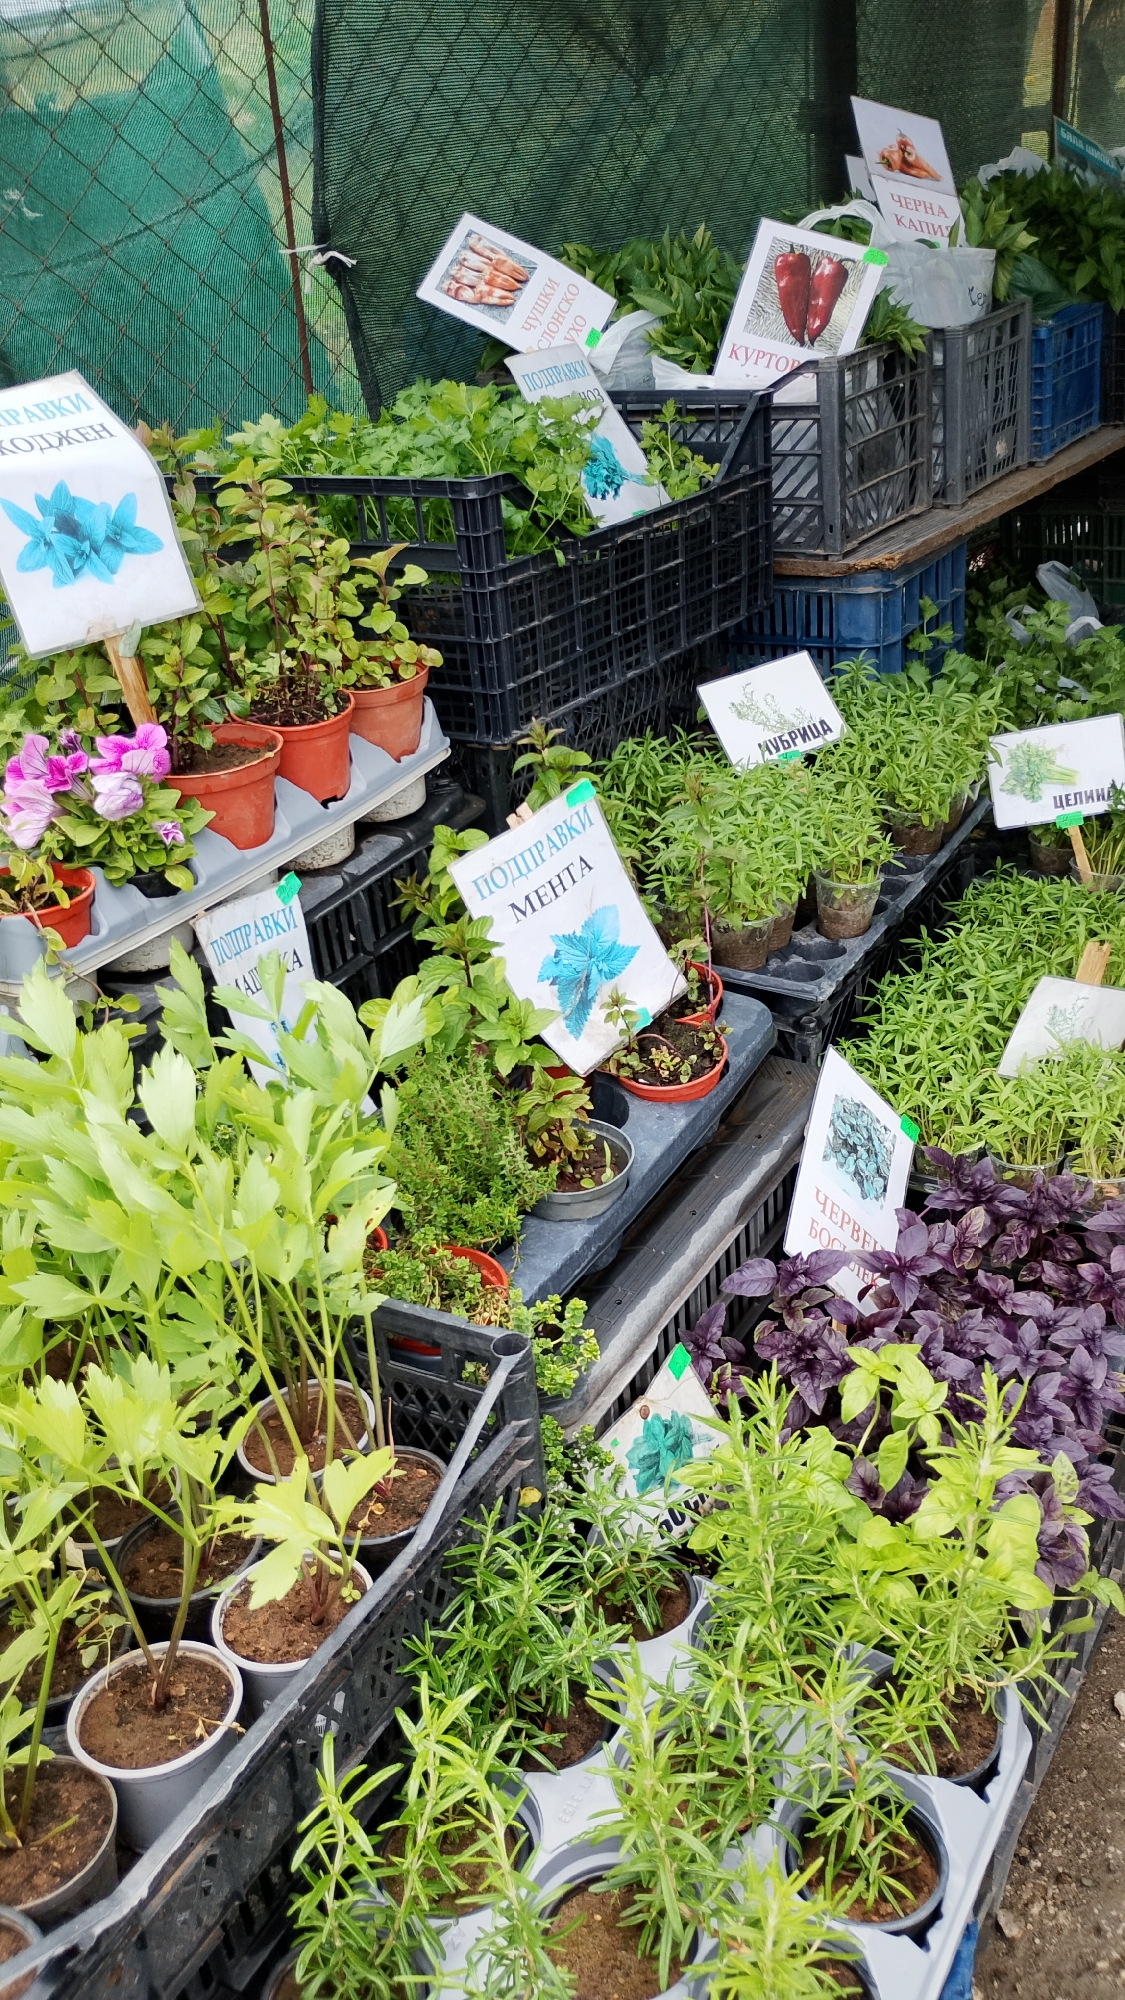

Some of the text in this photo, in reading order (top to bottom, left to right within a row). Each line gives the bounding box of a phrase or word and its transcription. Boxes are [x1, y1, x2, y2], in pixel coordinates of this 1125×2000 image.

[889, 192, 949, 219] ЧЕРНА
[520, 276, 560, 333] ЧУШКИ
[521, 359, 591, 392] ПОДПРАВКИ
[727, 343, 816, 380] КУРТОВ
[471, 804, 595, 901] ПОДПРАВКИ
[508, 854, 594, 924] МЕНТА
[210, 905, 298, 966] ПОДПРАВКИ
